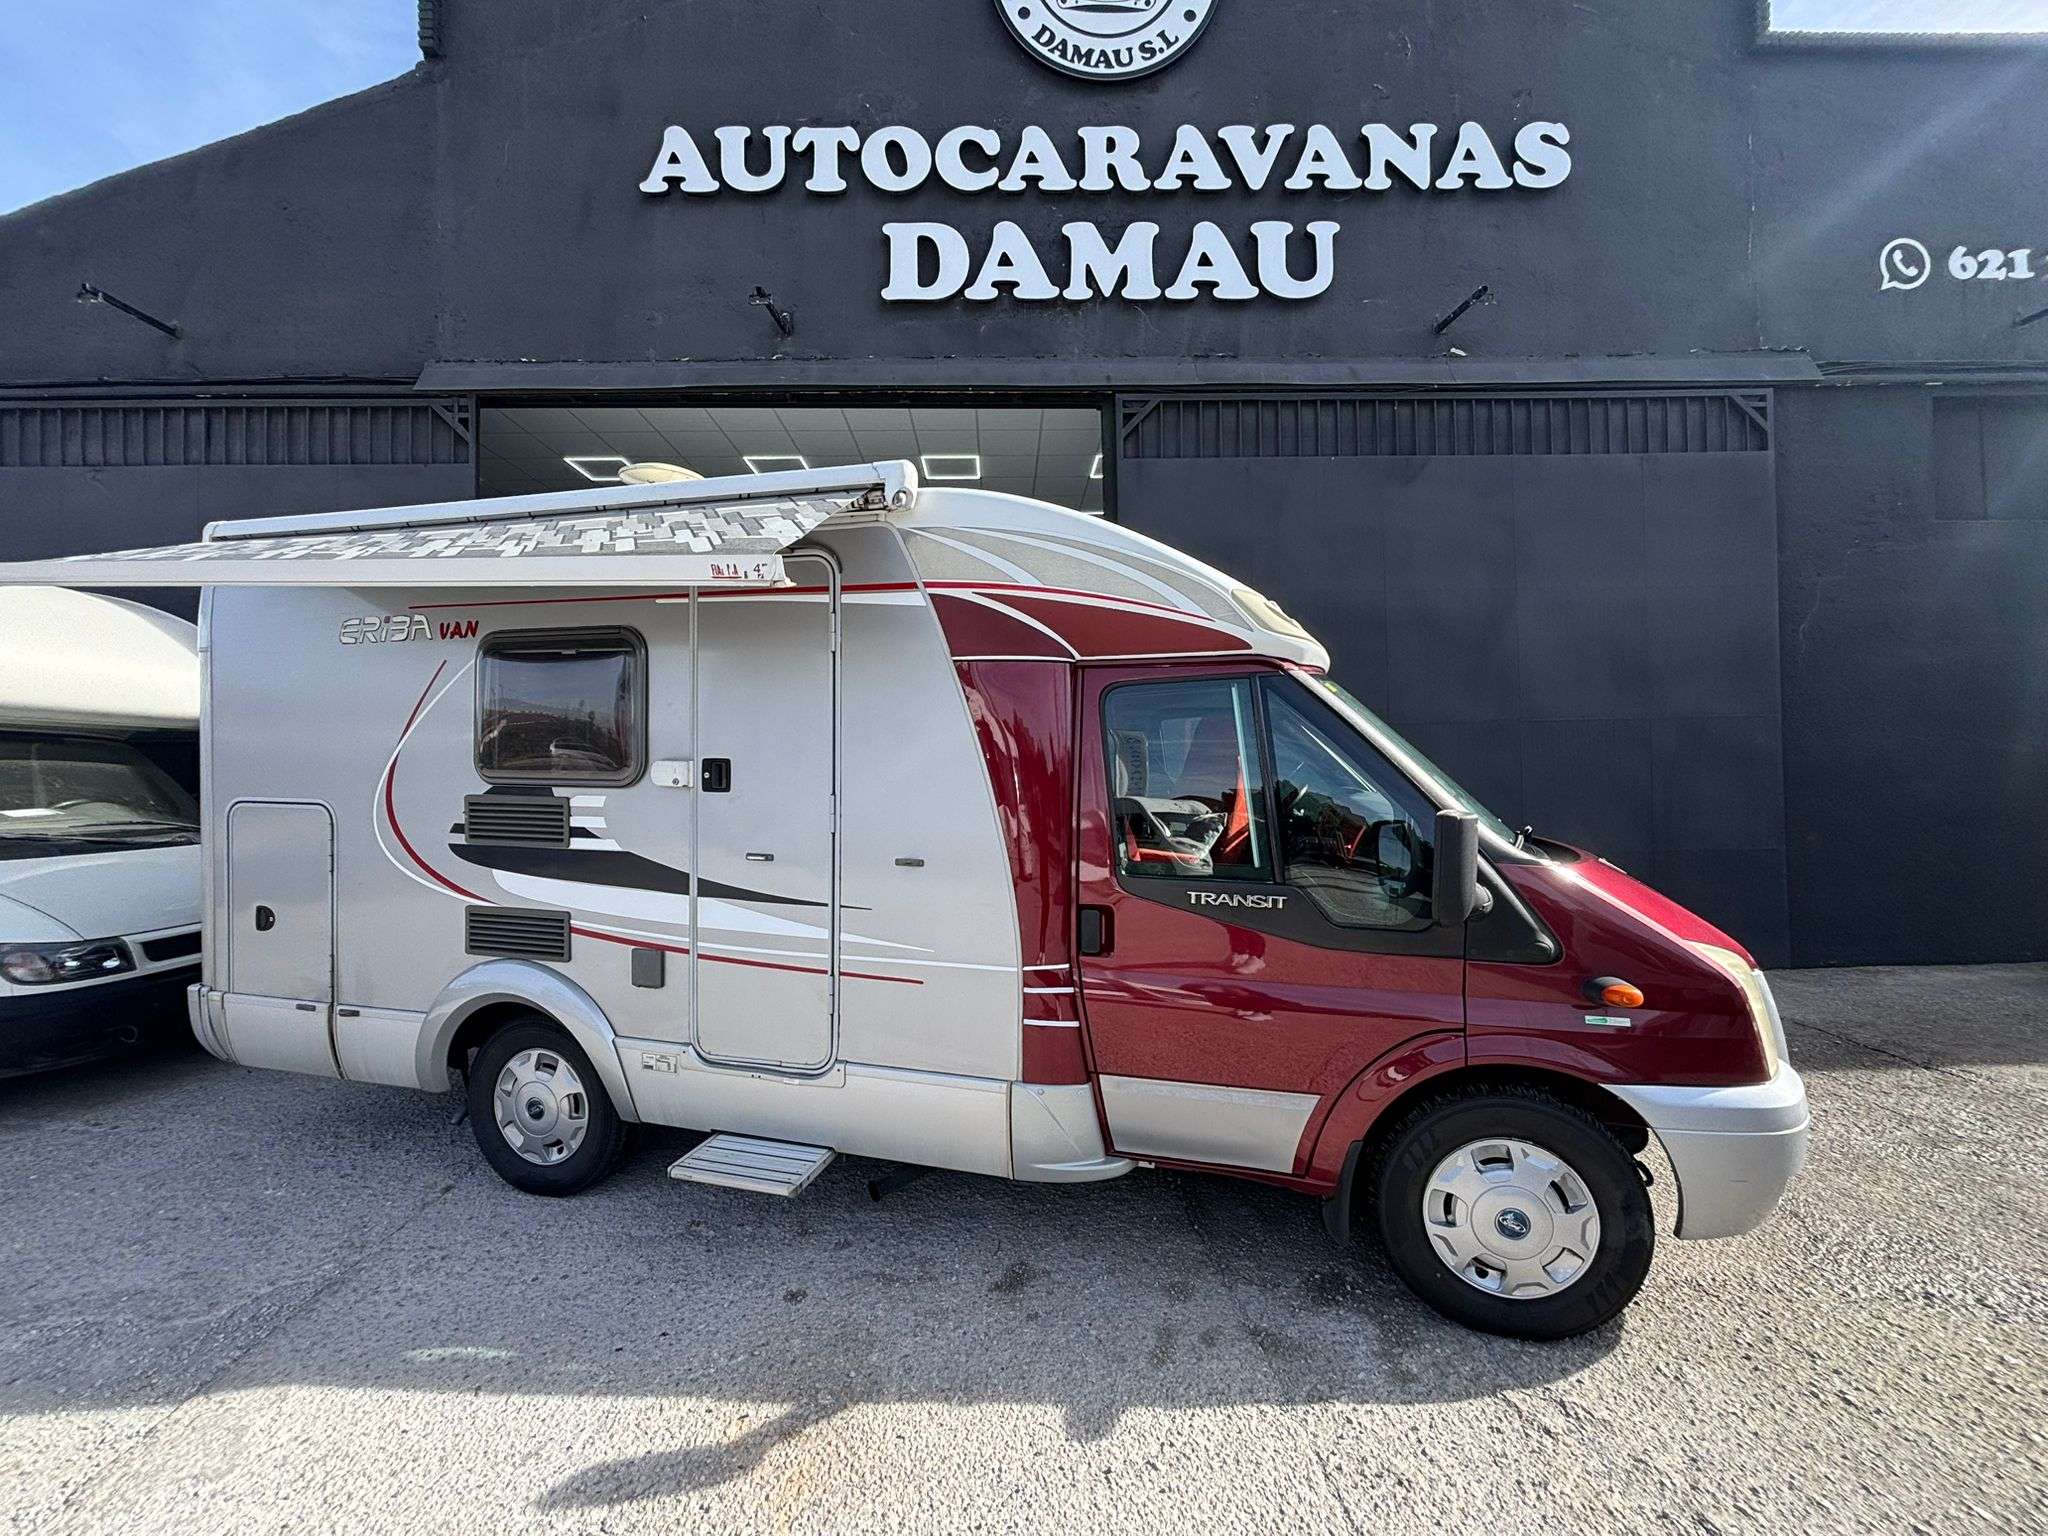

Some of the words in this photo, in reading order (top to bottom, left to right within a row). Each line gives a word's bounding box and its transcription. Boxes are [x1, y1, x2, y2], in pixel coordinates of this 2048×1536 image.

[1031, 23, 1134, 69] DAMAU
[1138, 29, 1179, 61] S.L
[639, 121, 1572, 193] AUTOCARAVANAS
[880, 220, 1341, 302] DAMAU
[1947, 245, 2036, 281] 621
[439, 620, 479, 641] VAN
[1187, 891, 1288, 909] TRANSIT
